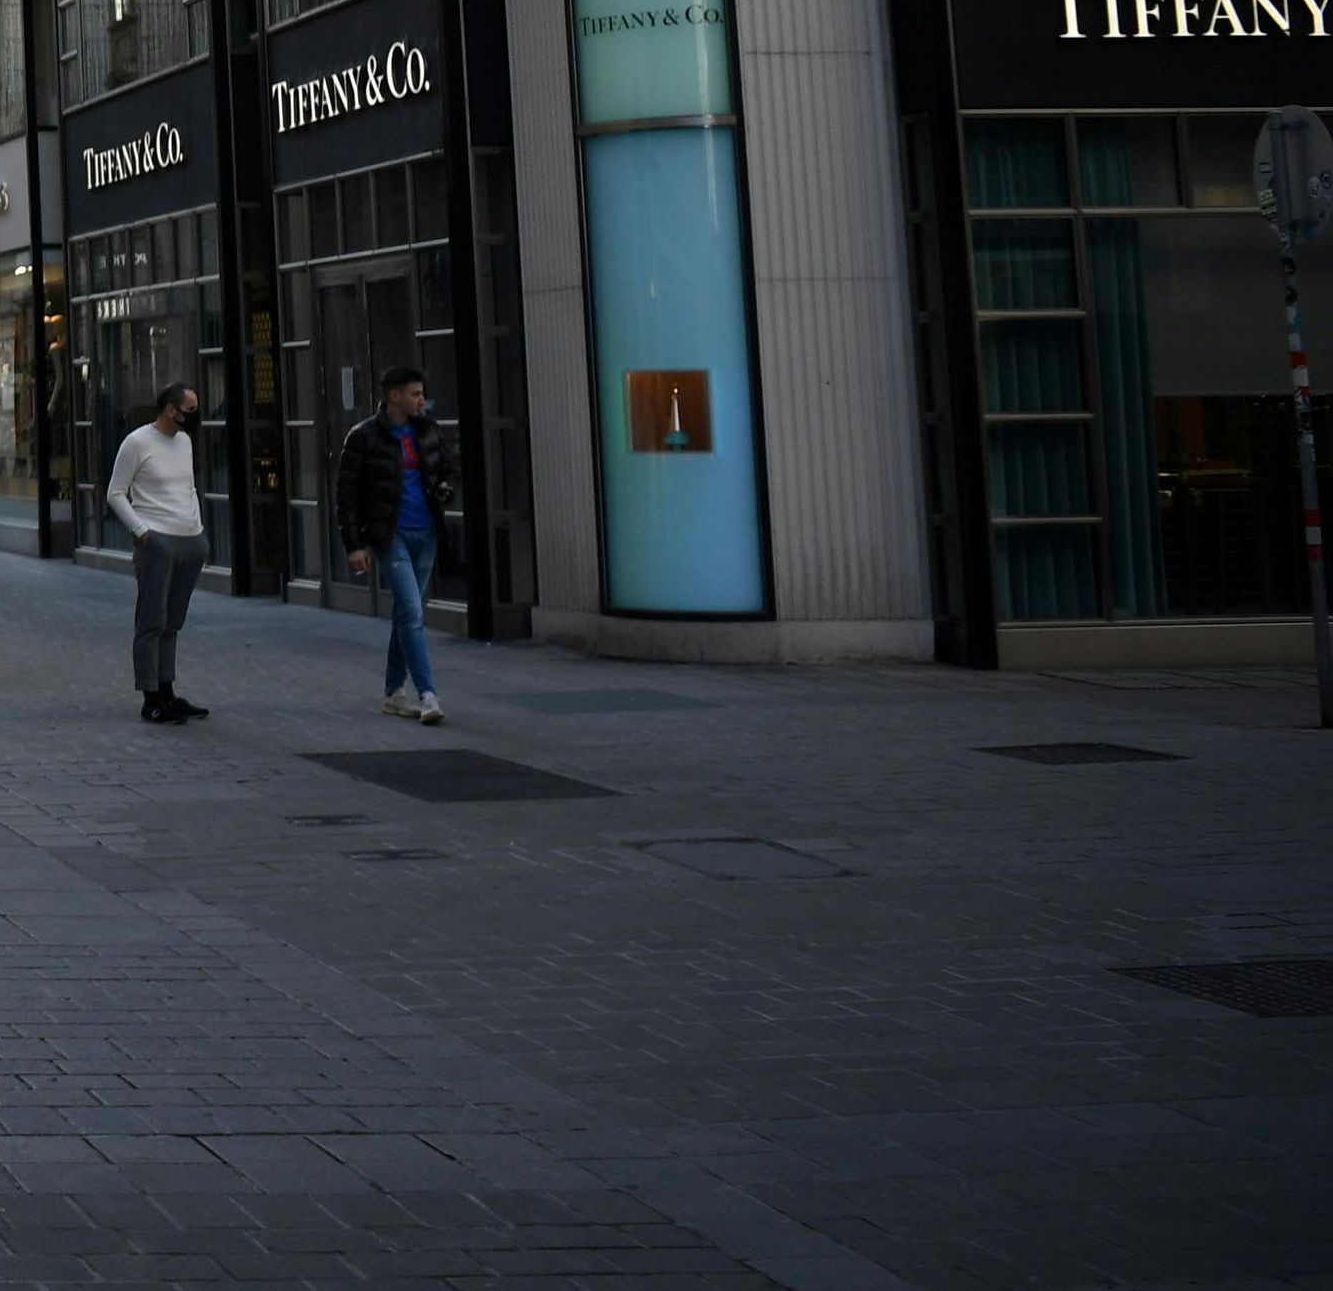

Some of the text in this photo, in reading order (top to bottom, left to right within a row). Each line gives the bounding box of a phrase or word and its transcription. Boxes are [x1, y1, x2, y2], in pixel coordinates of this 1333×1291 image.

[579, 11, 659, 37] TIFFANY
[663, 8, 679, 26] &
[273, 65, 362, 133] TIFFANY
[365, 54, 385, 106] &
[82, 139, 142, 190] TIFFANY
[142, 130, 155, 173] &
